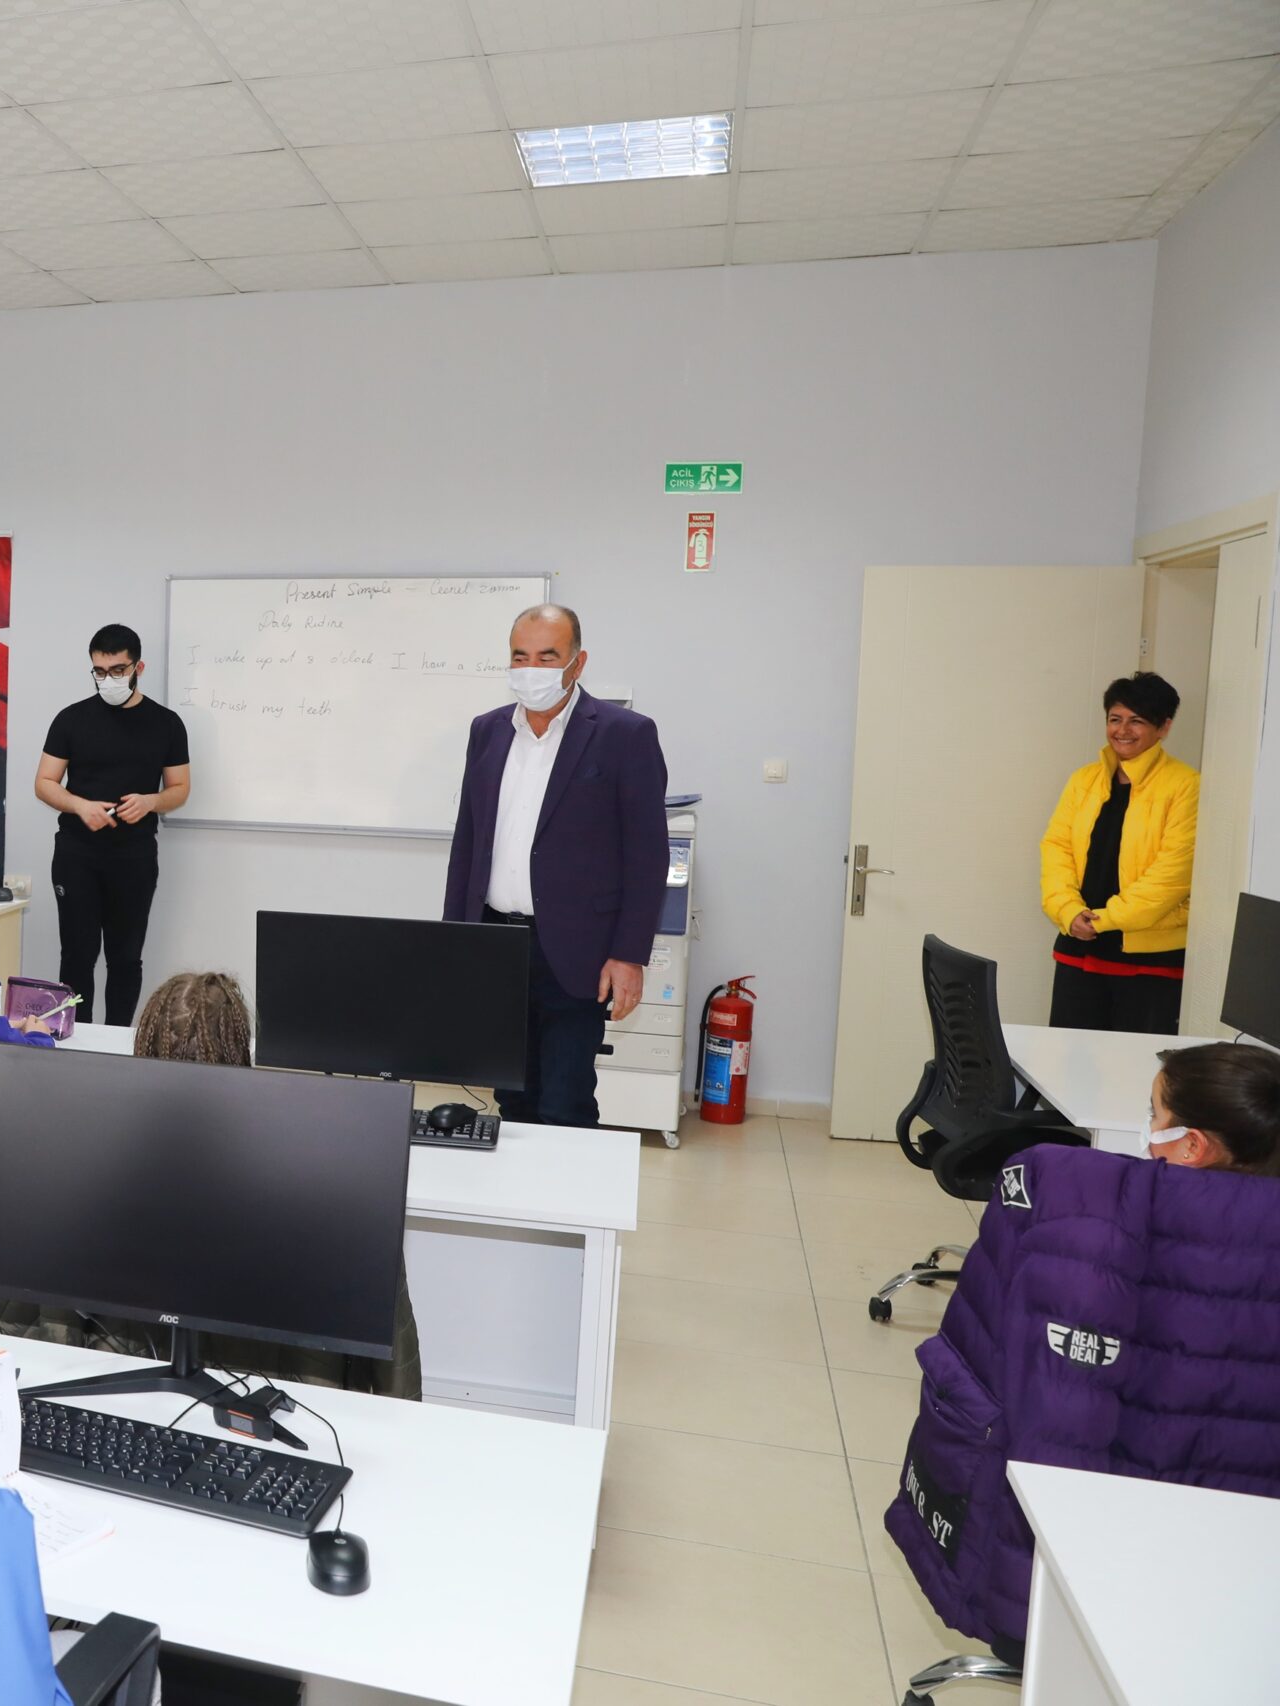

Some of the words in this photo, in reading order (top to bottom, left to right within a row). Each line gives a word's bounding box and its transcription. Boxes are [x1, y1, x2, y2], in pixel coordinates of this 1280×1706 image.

[671, 468, 694, 477] ACİL
[669, 479, 695, 488] ÇIKIŞ
[285, 581, 337, 605] Present
[347, 580, 393, 600] Simple
[185, 644, 201, 666] I
[214, 650, 246, 665] wake
[255, 656, 273, 671] up
[279, 649, 297, 665] at
[391, 652, 409, 670] I
[457, 663, 465, 671] a
[179, 687, 200, 706] I
[210, 689, 248, 714] brush
[261, 703, 284, 719] my
[298, 697, 333, 716] teeth
[158, 1314, 180, 1325] AOC
[1071, 1329, 1101, 1351] REAL
[1069, 1346, 1098, 1366] DEAL
